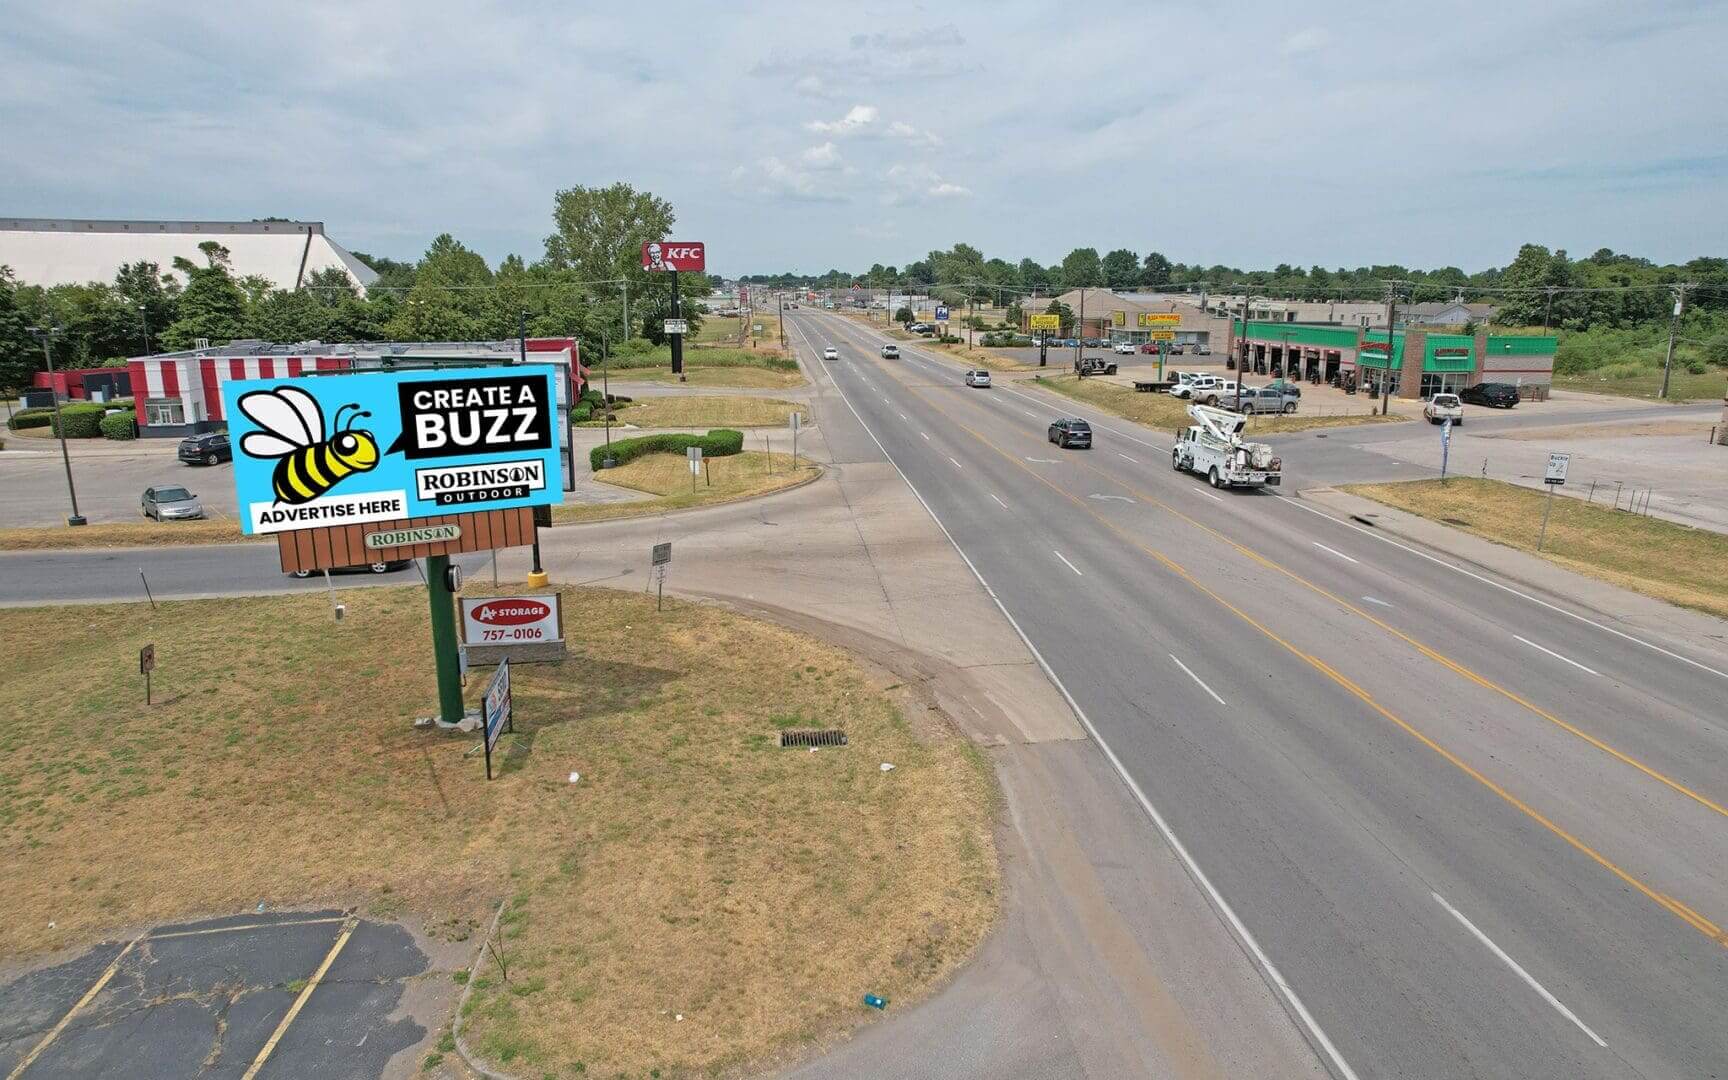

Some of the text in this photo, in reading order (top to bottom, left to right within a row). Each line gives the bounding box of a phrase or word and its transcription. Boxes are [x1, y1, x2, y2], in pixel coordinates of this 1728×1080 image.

[667, 248, 701, 259] KFC
[414, 384, 536, 410] CREATE A
[415, 406, 540, 449] BUZZ
[423, 465, 540, 491] ROBINSON
[443, 487, 523, 503] OUTDOOR
[259, 498, 401, 525] ADVERTISE HERE
[372, 527, 455, 546] ROBINSON
[479, 606, 545, 621] A+ STORAGE
[483, 628, 542, 641] 757-0106
